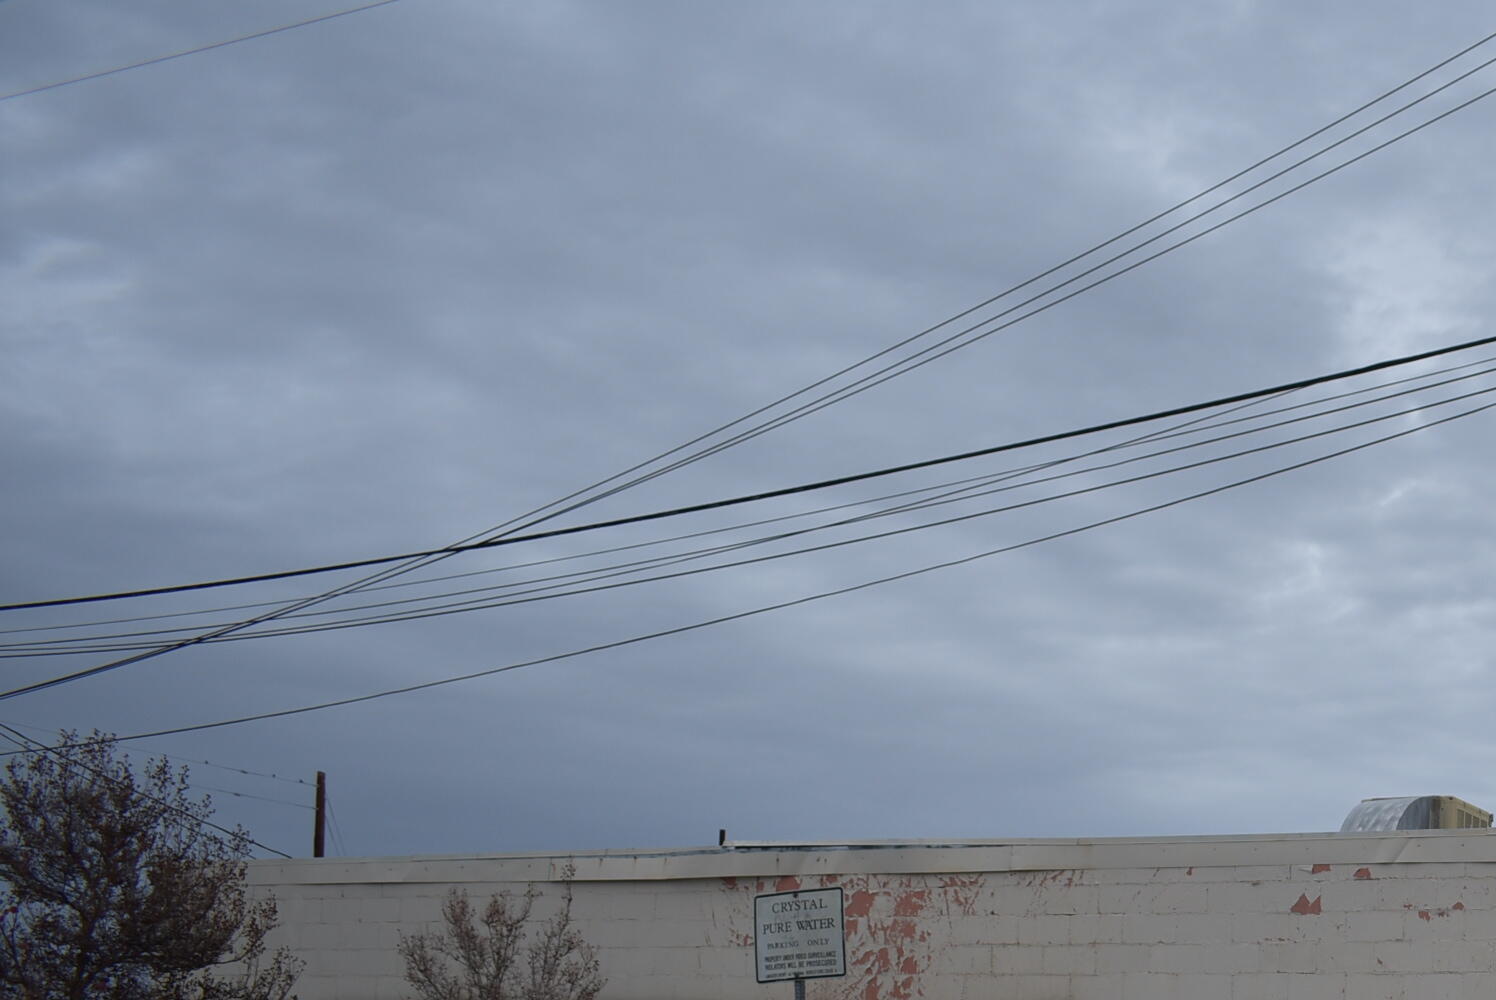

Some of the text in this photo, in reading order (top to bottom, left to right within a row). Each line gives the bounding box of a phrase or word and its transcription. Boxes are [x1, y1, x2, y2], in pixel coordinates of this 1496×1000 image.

[772, 898, 828, 914] CRYSTAL
[763, 917, 836, 935] PURE WATER
[767, 941, 799, 949] PARKING
